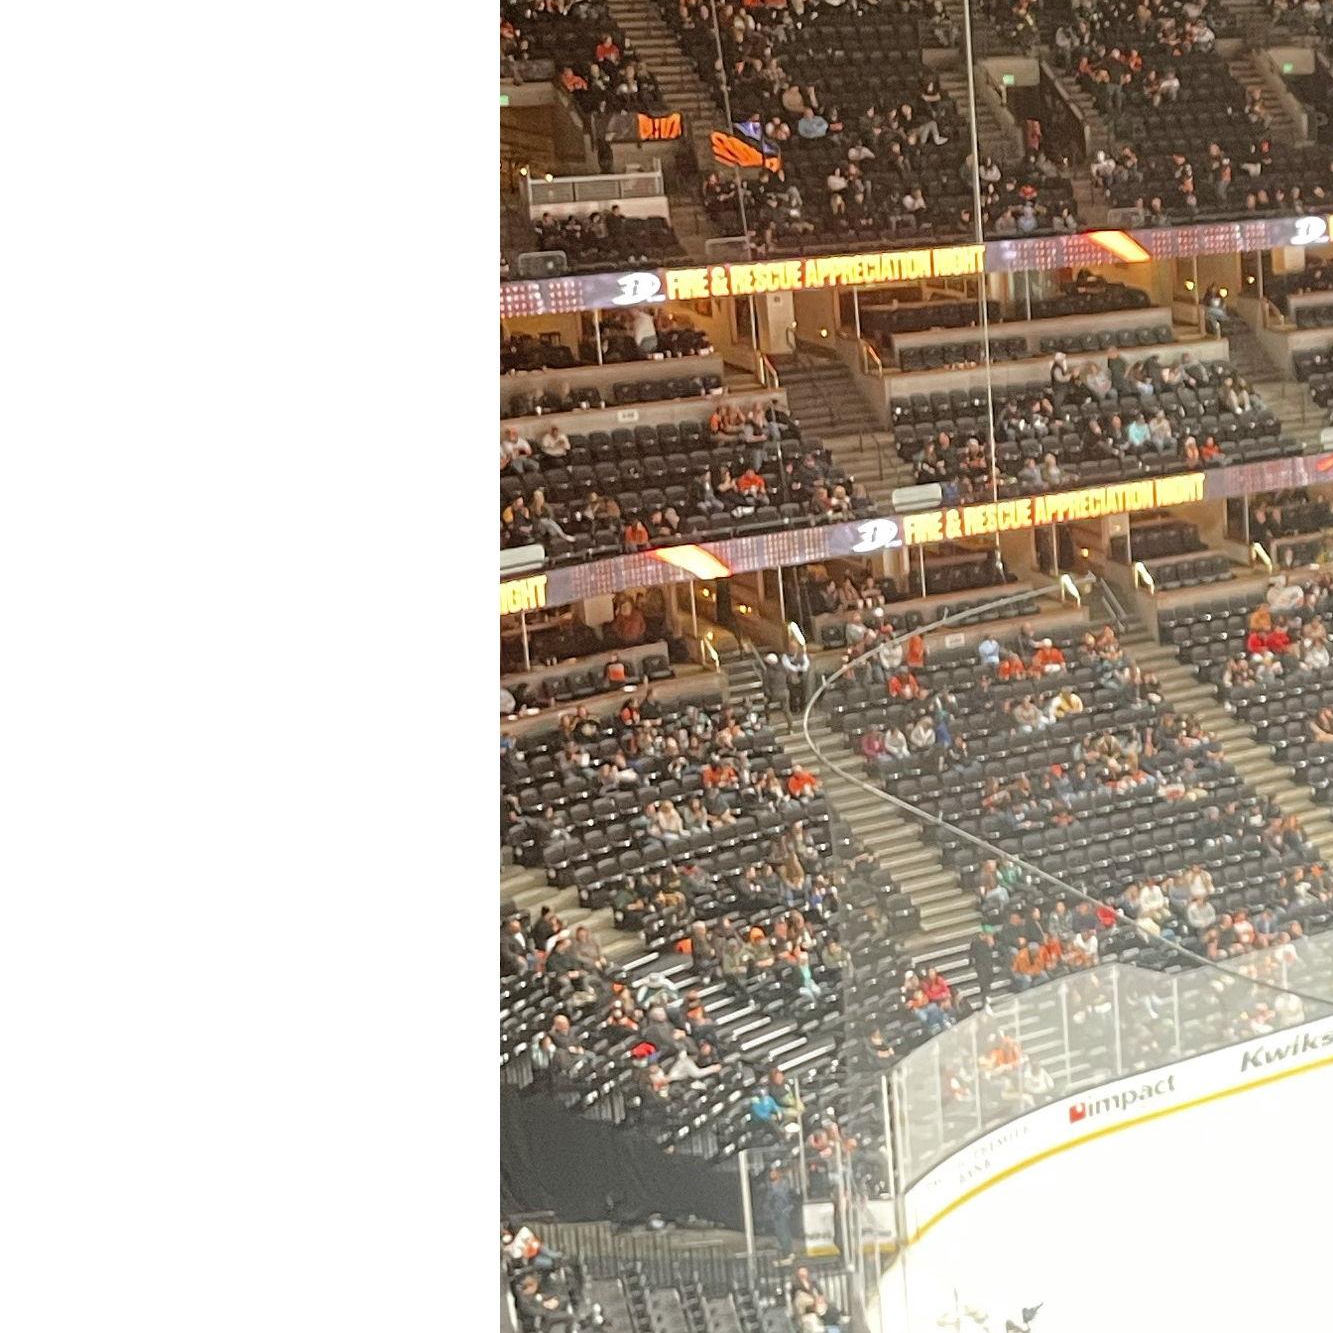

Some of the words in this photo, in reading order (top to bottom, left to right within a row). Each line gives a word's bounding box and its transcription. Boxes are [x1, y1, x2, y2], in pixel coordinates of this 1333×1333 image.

[804, 249, 932, 289] APPRECIATION
[964, 499, 1033, 537] RESCUE
[1034, 480, 1154, 526] APPRECIATION
[500, 574, 547, 616] IGHT
[1087, 1074, 1175, 1116] impact
